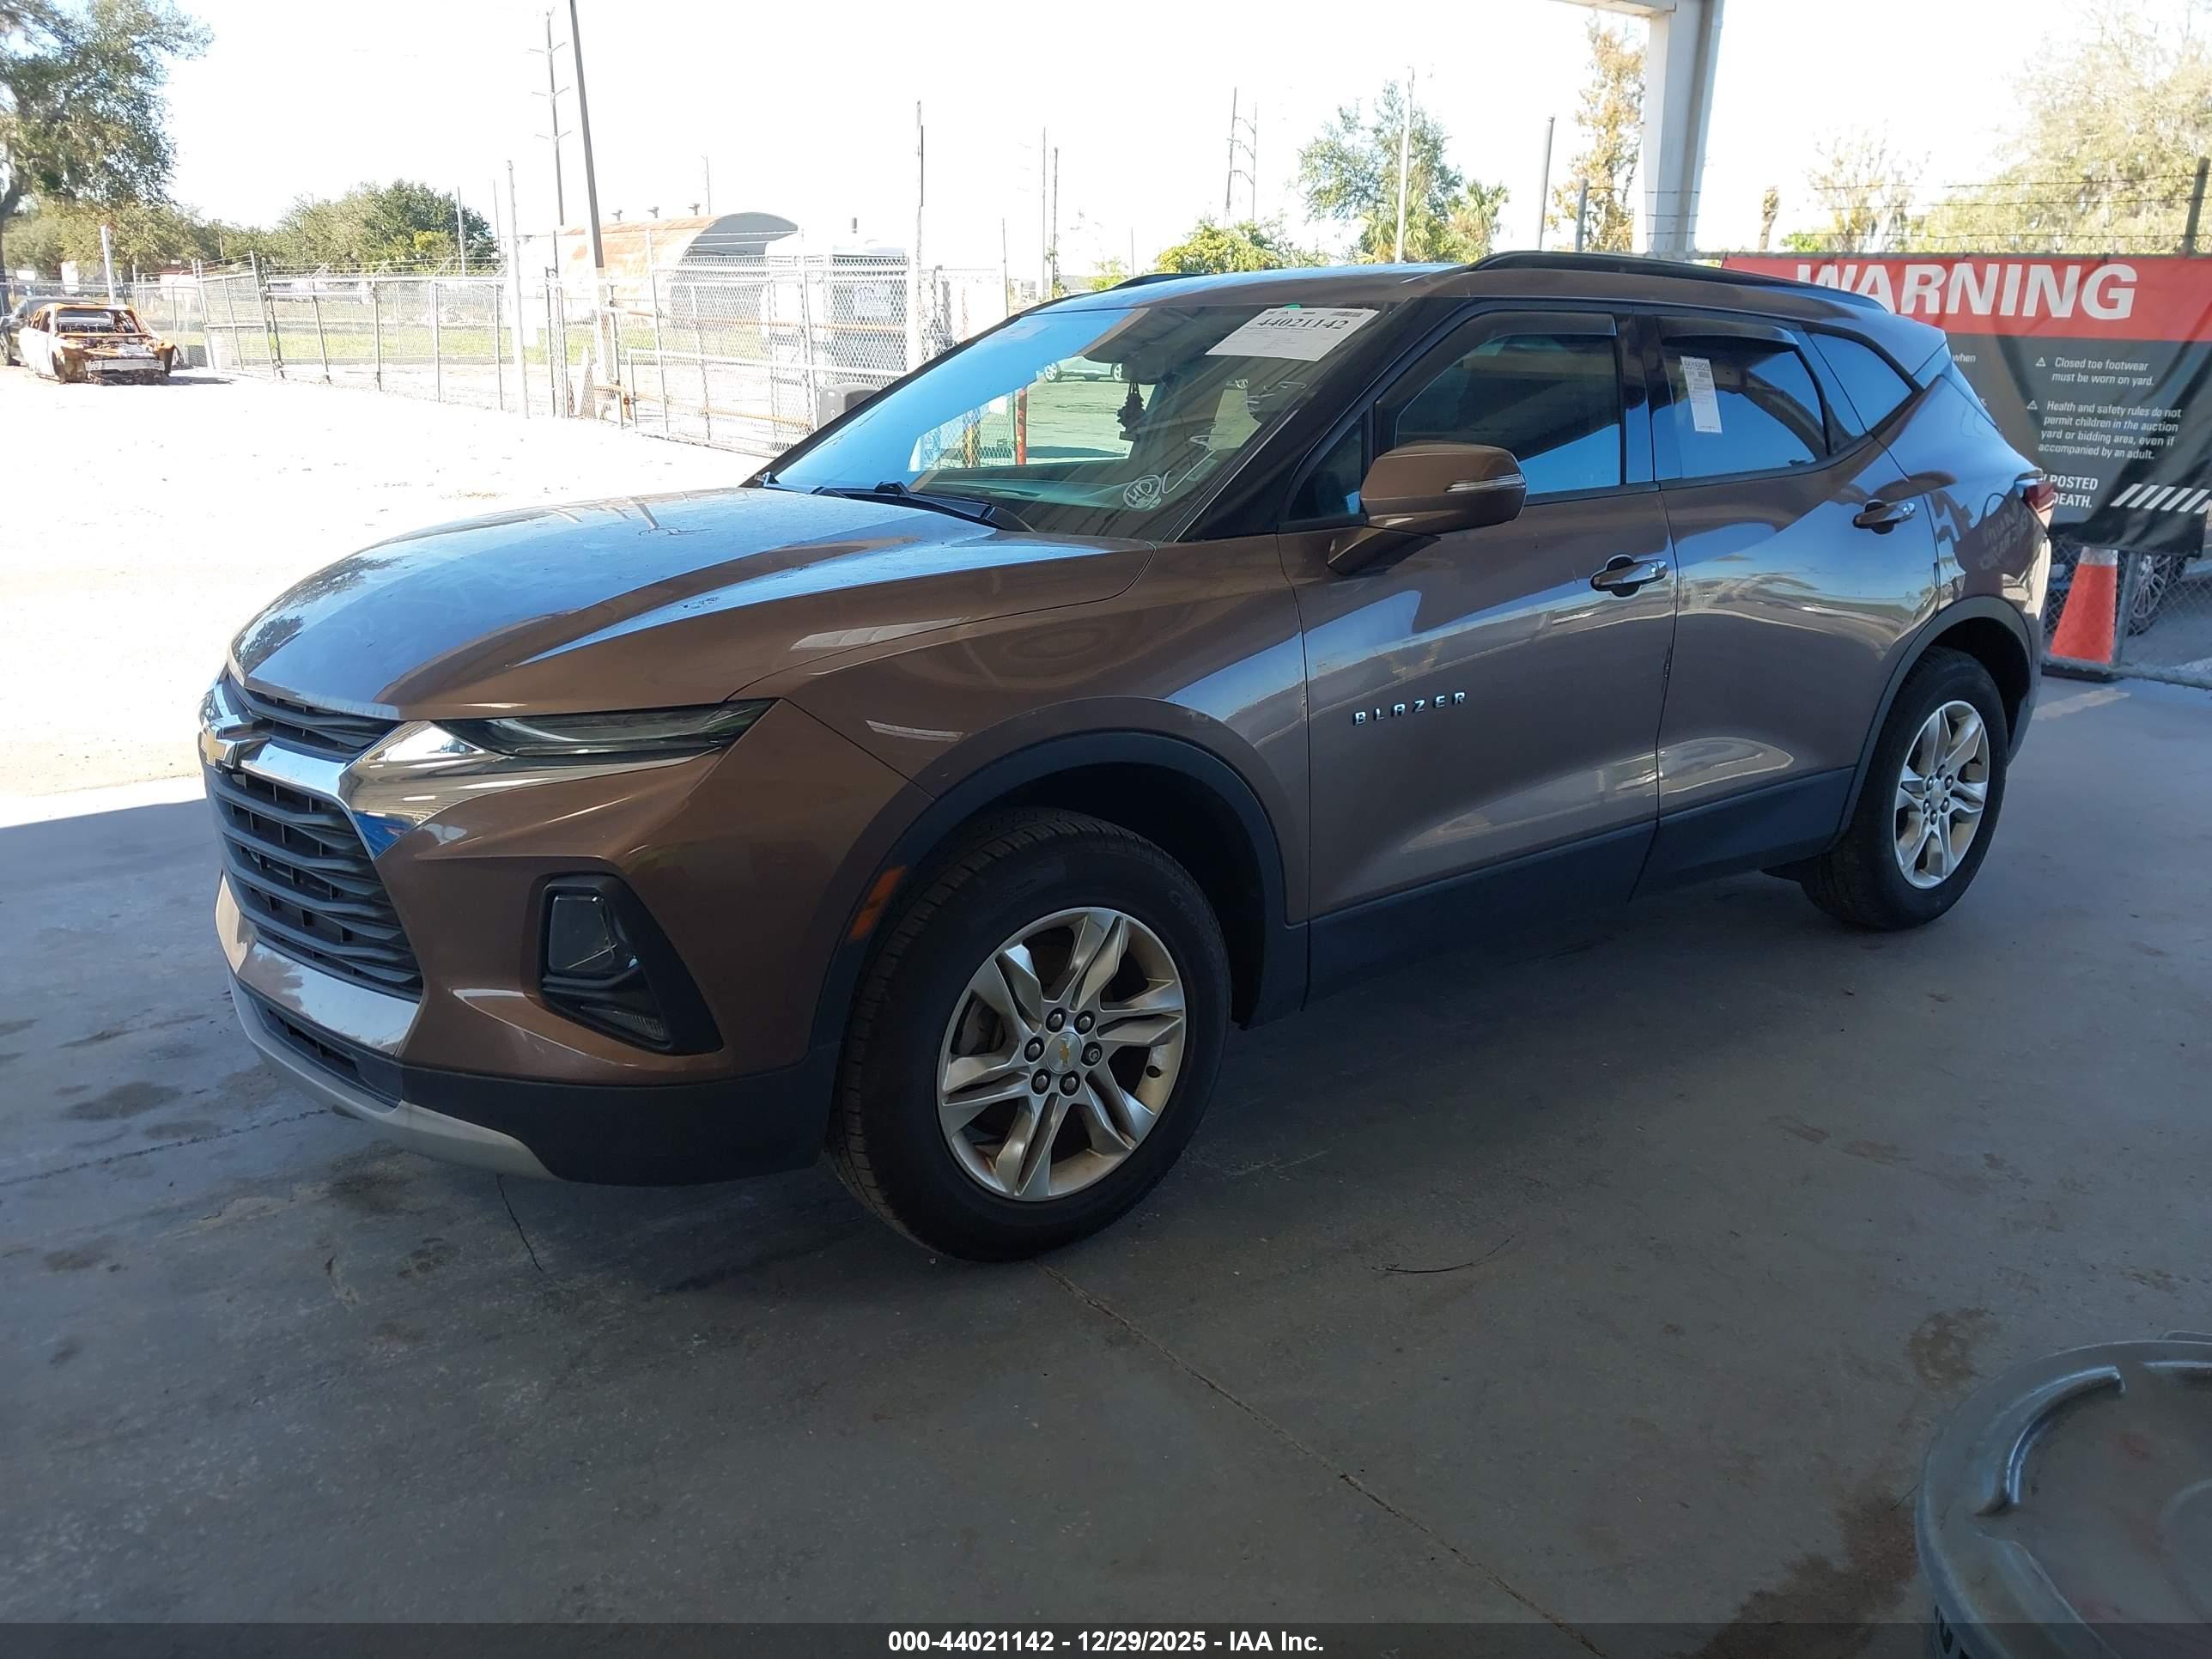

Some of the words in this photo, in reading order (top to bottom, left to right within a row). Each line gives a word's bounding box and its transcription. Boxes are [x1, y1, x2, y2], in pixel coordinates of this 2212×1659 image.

[1257, 318, 1349, 330] 44021142
[2055, 356, 2087, 368] Closed
[2088, 359, 2103, 369] toe
[2106, 359, 2148, 372] footwear
[2052, 373, 2075, 382] must
[2077, 372, 2088, 383] be
[2118, 376, 2130, 385] on
[2132, 376, 2154, 386] yard.
[2047, 400, 2075, 412] Health
[2078, 404, 2095, 413] and
[2097, 404, 2128, 416] safety
[2128, 406, 2149, 416] rules
[2152, 407, 2162, 417] do
[2165, 409, 2182, 418] not
[2044, 416, 2073, 427] permit
[2075, 417, 2112, 428] children
[2113, 419, 2122, 428] in
[2124, 419, 2139, 430] the
[2141, 422, 2179, 433] auction
[2041, 429, 2063, 440] yard
[2078, 432, 2112, 443] bidding
[2114, 434, 2136, 447] area,
[2139, 438, 2164, 447] even
[2166, 436, 2175, 447] if
[2039, 443, 2100, 457] accompanied
[2102, 447, 2112, 459] by
[2114, 448, 2125, 457] an
[2127, 448, 2155, 460] adult.
[2050, 474, 2099, 490] POSTED
[2054, 492, 2093, 508] DEATH.
[1353, 691, 1466, 726] BLAZER
